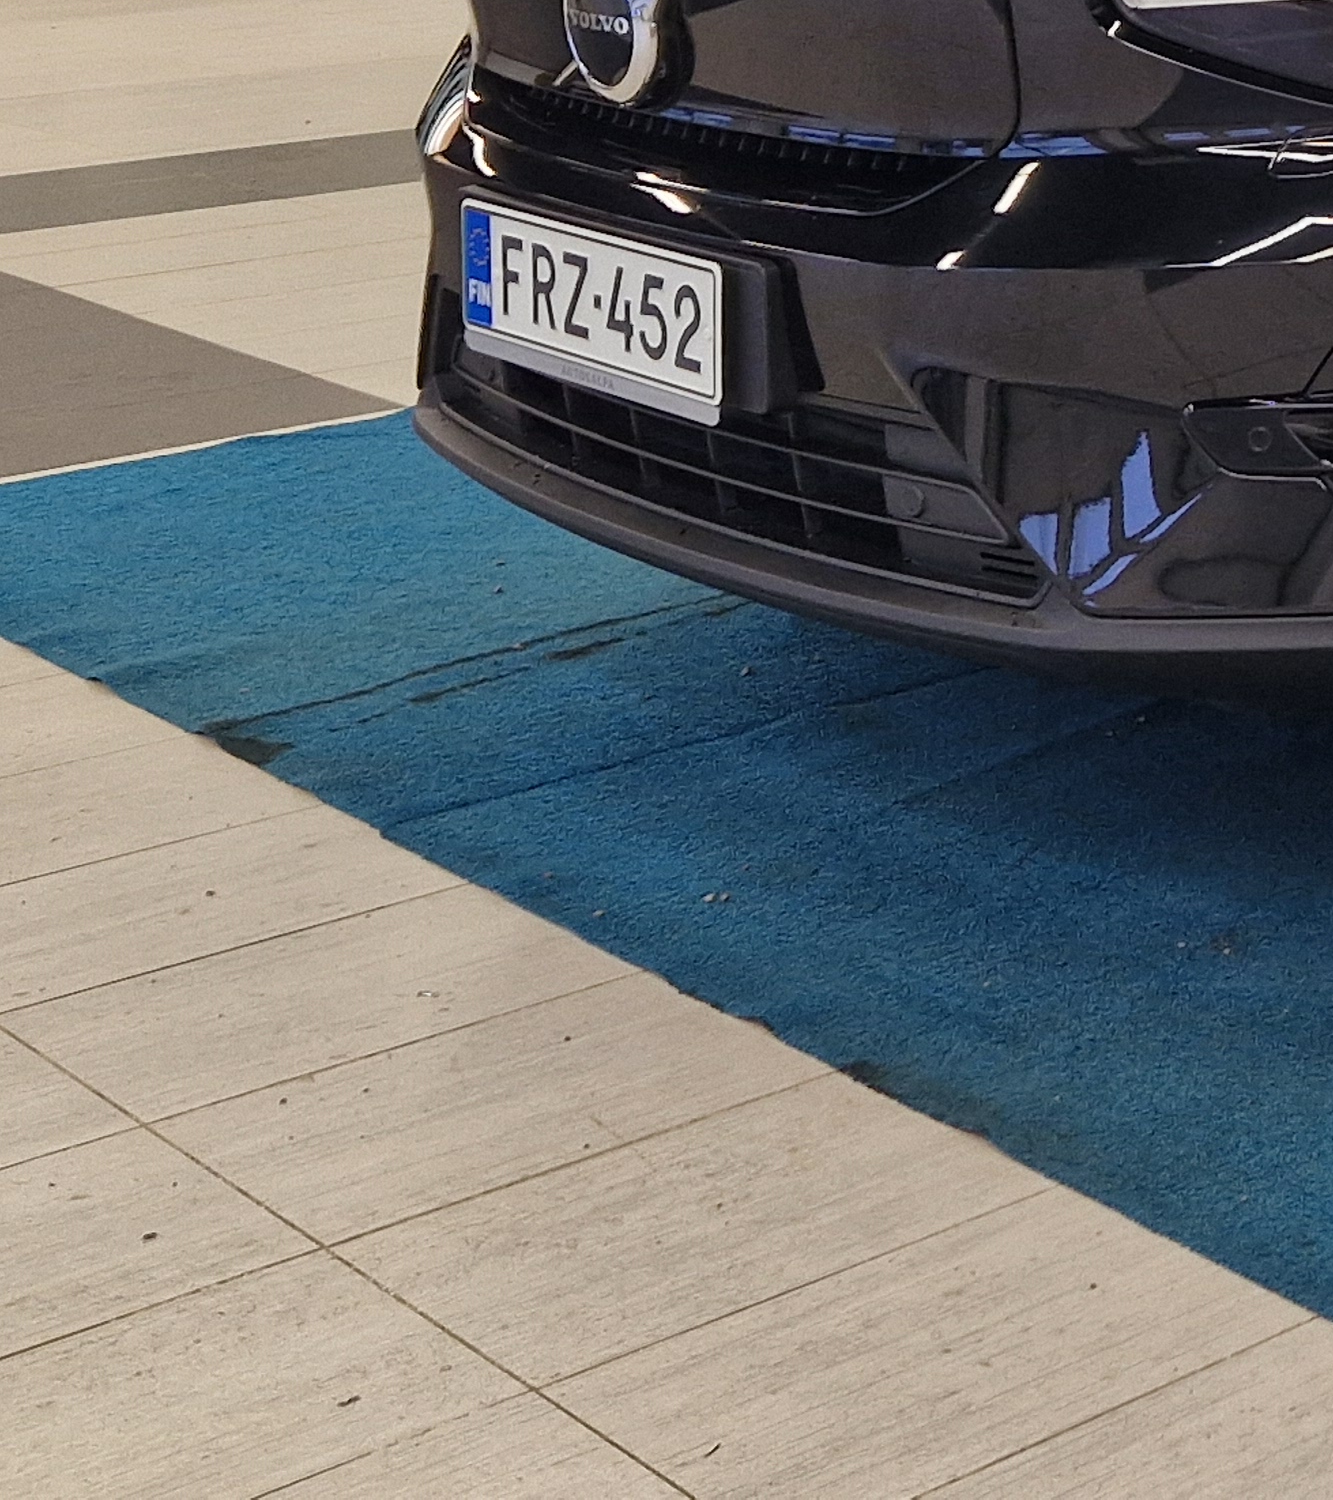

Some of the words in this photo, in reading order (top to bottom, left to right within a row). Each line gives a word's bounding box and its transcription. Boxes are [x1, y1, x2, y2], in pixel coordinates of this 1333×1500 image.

[568, 7, 630, 36] VOLVO
[468, 277, 492, 308] FIN
[501, 234, 702, 374] FRZ-452
